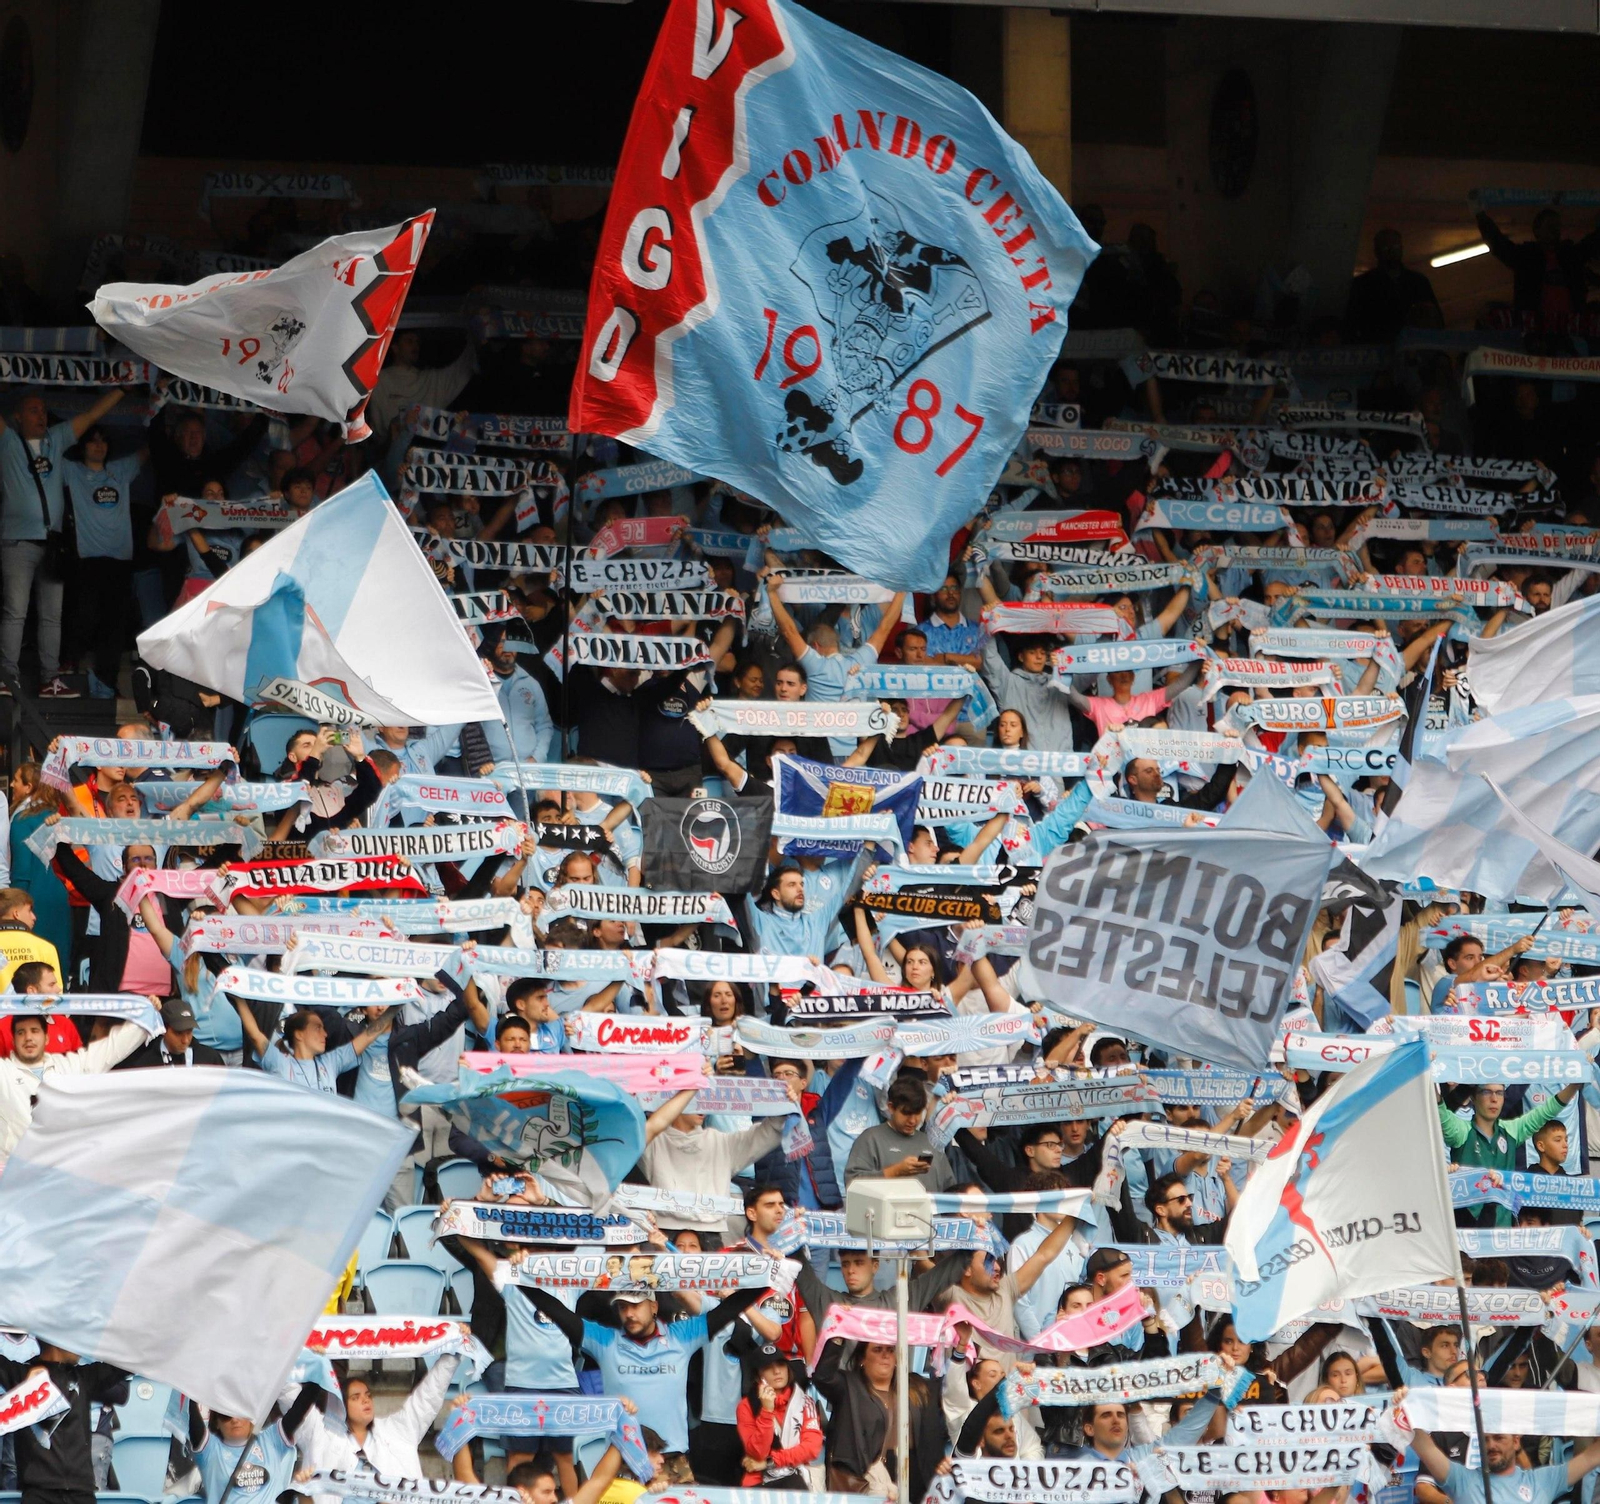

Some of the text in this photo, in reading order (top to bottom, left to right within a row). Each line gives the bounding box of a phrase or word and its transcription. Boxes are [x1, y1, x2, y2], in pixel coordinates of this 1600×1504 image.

[588, 0, 746, 383] VIGO
[756, 109, 1057, 335] COMANDO CELTA
[753, 308, 823, 389] 19
[1493, 353, 1534, 367] TROPAS
[893, 379, 985, 478] 87
[1068, 434, 1090, 450] DE
[1093, 436, 1132, 451] XOGO
[995, 520, 1034, 532] Celta
[1036, 528, 1059, 537] FINAL
[1060, 520, 1100, 530] MANCHESTER
[1542, 534, 1560, 547] DE
[572, 560, 710, 583] E-CHUZAS
[1384, 575, 1490, 594] CELTA DE VIGO
[595, 592, 743, 618] COMANDO
[572, 635, 707, 667] COMANDO
[1225, 658, 1265, 674] CELTA
[1269, 659, 1287, 674] DE
[787, 710, 807, 727] DE
[814, 711, 858, 727] XOGO
[1259, 703, 1322, 722] EURO
[1336, 696, 1405, 720] CELTA
[94, 738, 194, 760] CELTA
[1193, 751, 1215, 759] 2012
[556, 770, 633, 795] CELTA
[801, 763, 901, 785] NO SCOTLAND
[222, 782, 293, 801] ASPAS
[419, 786, 505, 804] CELTA VIGO
[932, 781, 992, 804] DE TEIS
[701, 801, 722, 813] TEIS
[351, 826, 495, 856] OLIVEIRA DE TEIS
[569, 889, 707, 916] OLIVEIRA DE TEIS
[896, 897, 982, 918] CLUB CELTA
[5, 954, 34, 962] LIARES
[322, 940, 432, 964] R.C. CELTA de
[480, 950, 626, 970] IAGO ASPAS
[249, 975, 383, 999] RC CELTA
[1540, 981, 1600, 1006] CELT
[833, 997, 859, 1013] NA
[597, 1017, 692, 1046] Carcamäns
[952, 1065, 1036, 1088] CELTA
[1084, 1080, 1107, 1088] BEST
[1155, 1077, 1248, 1098] CELTA VIG
[1023, 1093, 1071, 1110] CELTA
[1077, 1087, 1124, 1106] VIGO
[1532, 1174, 1595, 1196] CELTA
[500, 1224, 606, 1242] CELESTES
[809, 1218, 847, 1238] IGO
[1491, 1227, 1566, 1252] CELTA
[521, 1254, 773, 1280] IAGO ASPAS
[1133, 1246, 1223, 1279] ELTA
[535, 1277, 740, 1289] ETERNO CAPITÁN
[1374, 1289, 1429, 1309] ORA
[1470, 1291, 1544, 1313] XOGO
[304, 1320, 453, 1349] arcamäns
[617, 1363, 677, 1376] CITROËN
[1050, 1363, 1203, 1395] siareiros.net
[479, 1403, 533, 1425] R.C.
[1177, 1446, 1361, 1476] LE-CHUZAS
[235, 1477, 265, 1488] Galicia
[985, 1491, 1039, 1502] ESTAMOS
